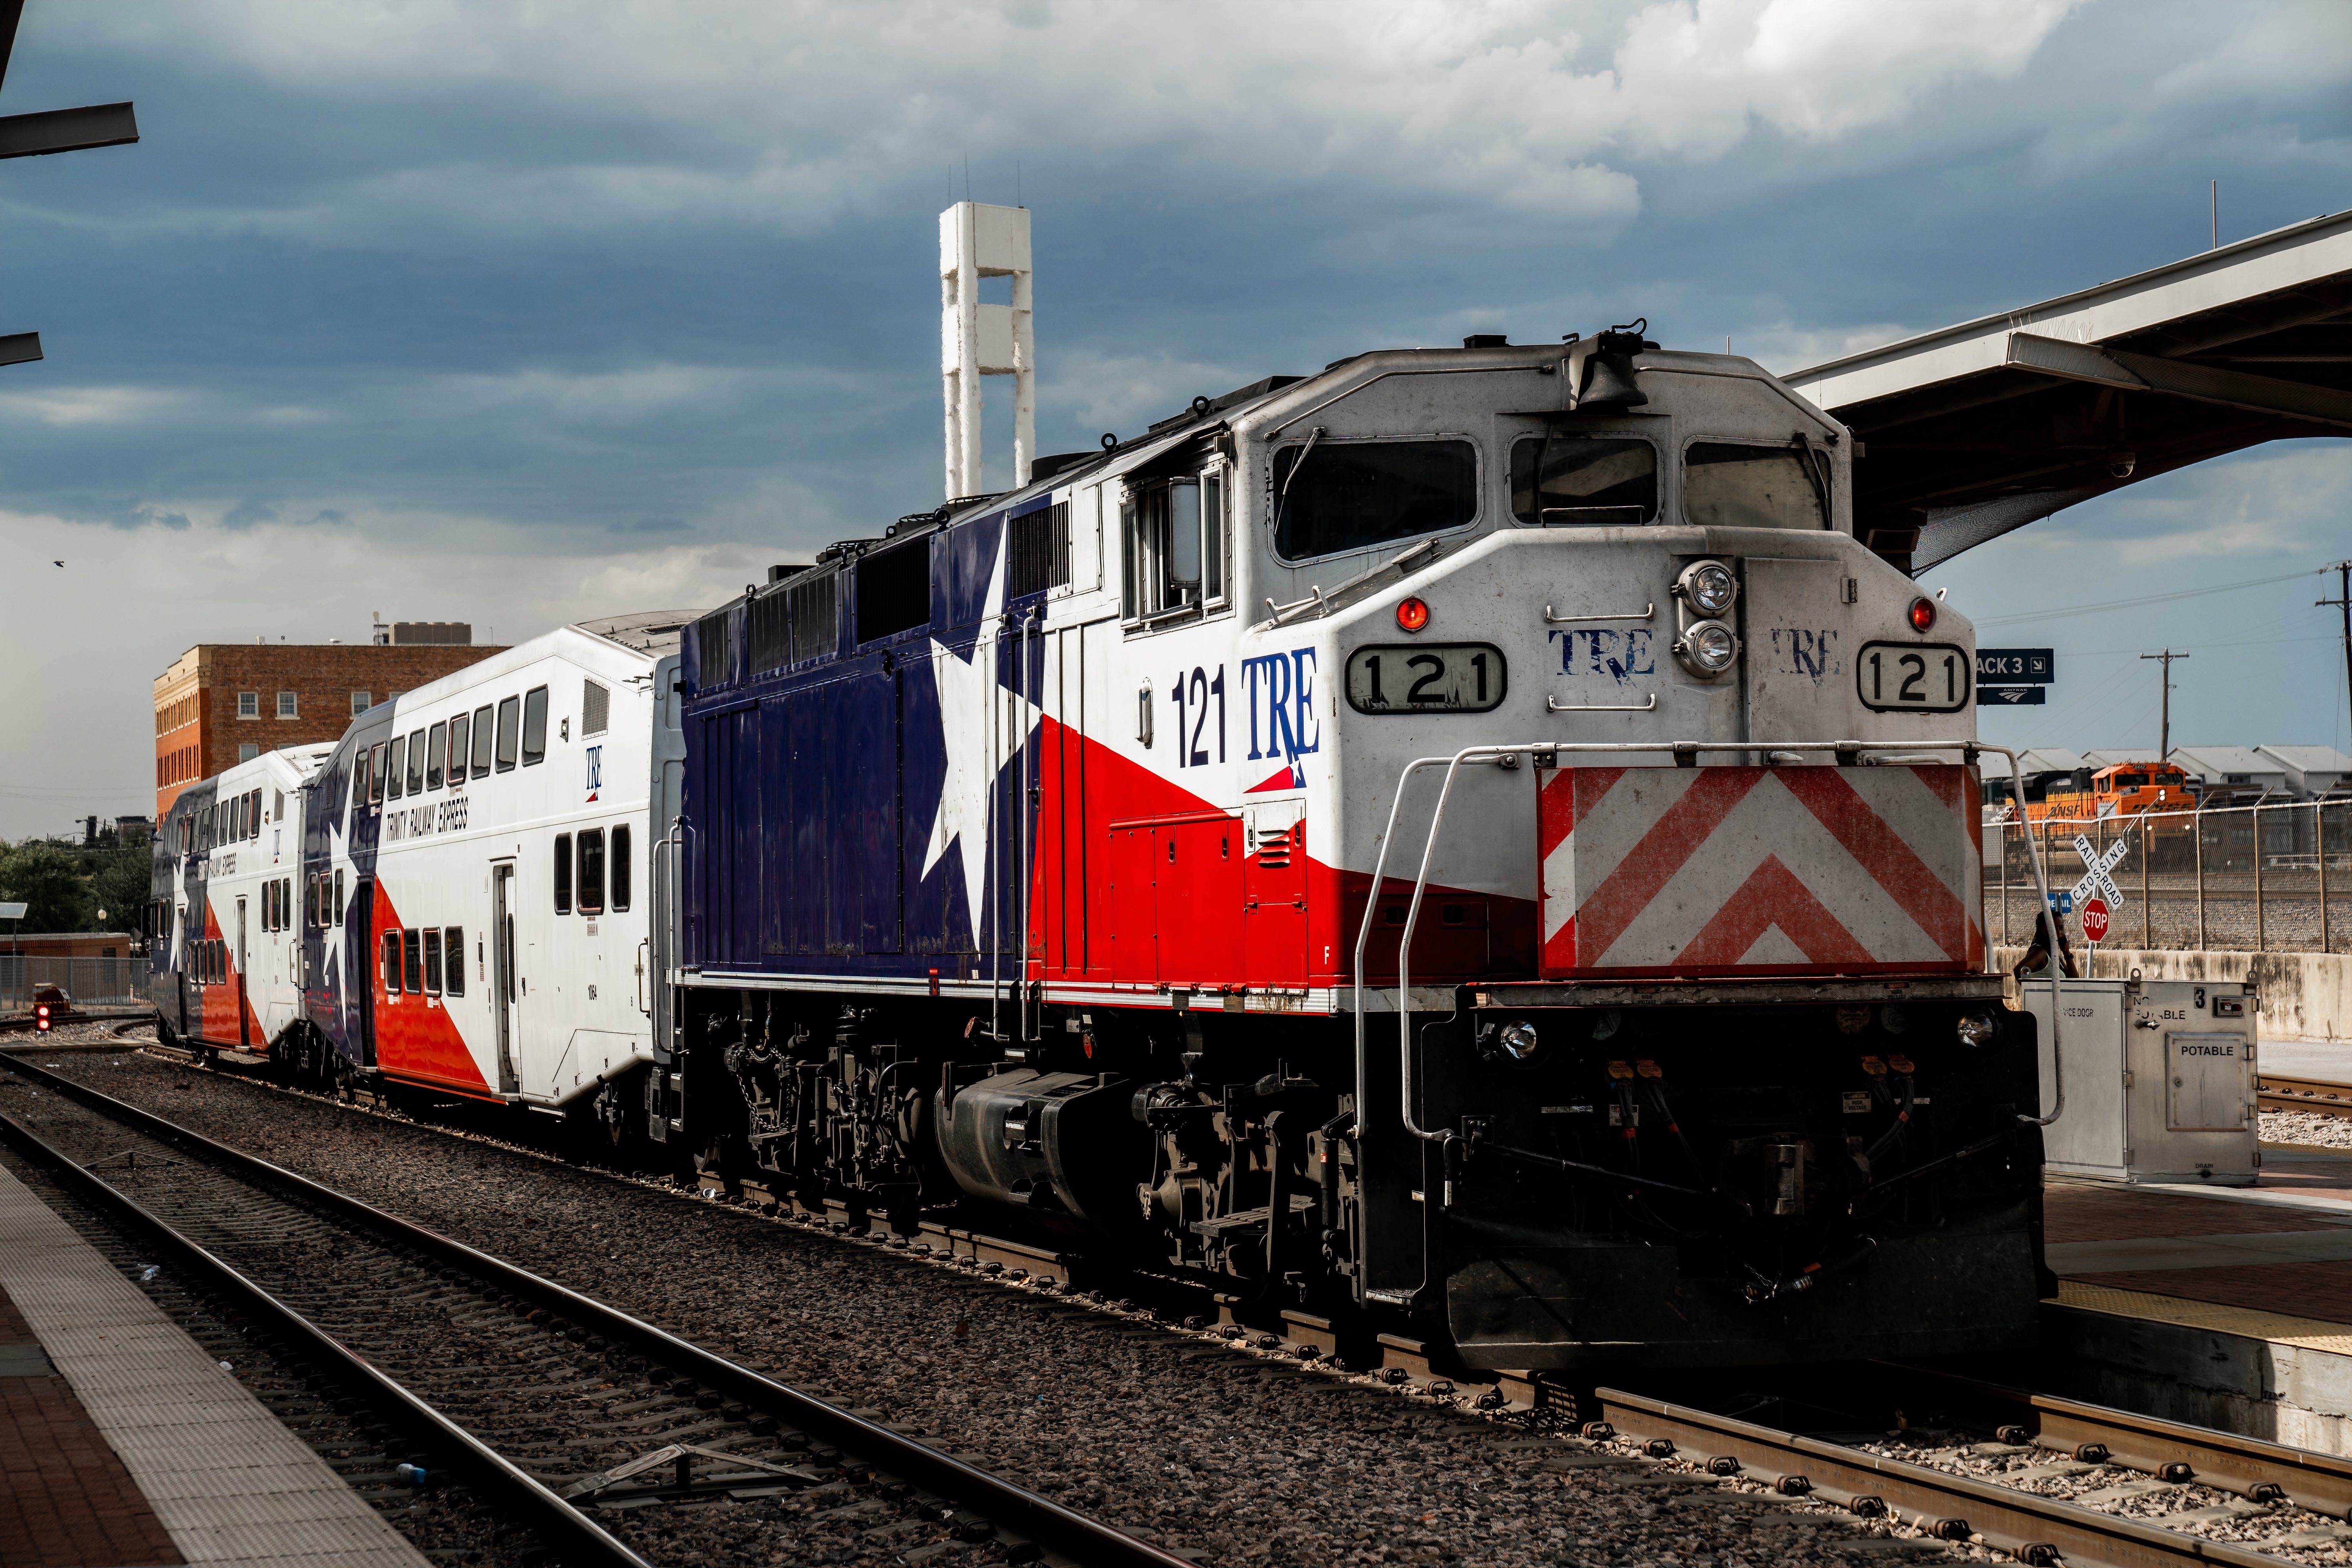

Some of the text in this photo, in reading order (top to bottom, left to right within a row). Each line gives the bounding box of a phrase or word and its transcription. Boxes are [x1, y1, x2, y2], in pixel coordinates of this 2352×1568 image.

[1365, 653, 1487, 703] 121
[1549, 630, 1655, 688] TRE
[1770, 628, 1840, 688] TRE
[1869, 652, 1955, 702] 121
[2012, 658, 2023, 673] 3
[1172, 663, 1225, 768] 121
[1241, 646, 1319, 788] TRE
[586, 745, 602, 801] TRE
[387, 796, 468, 842] TRINITY RAILWAY EXPRESS
[2074, 843, 2124, 900] CROSSING
[2076, 837, 2120, 905] RAIL ROAD
[2084, 911, 2107, 929] STOP
[1325, 946, 1329, 964] F
[588, 984, 597, 1000] 1064
[2196, 987, 2205, 1009] 3
[2181, 1046, 2234, 1056] POTABLE
